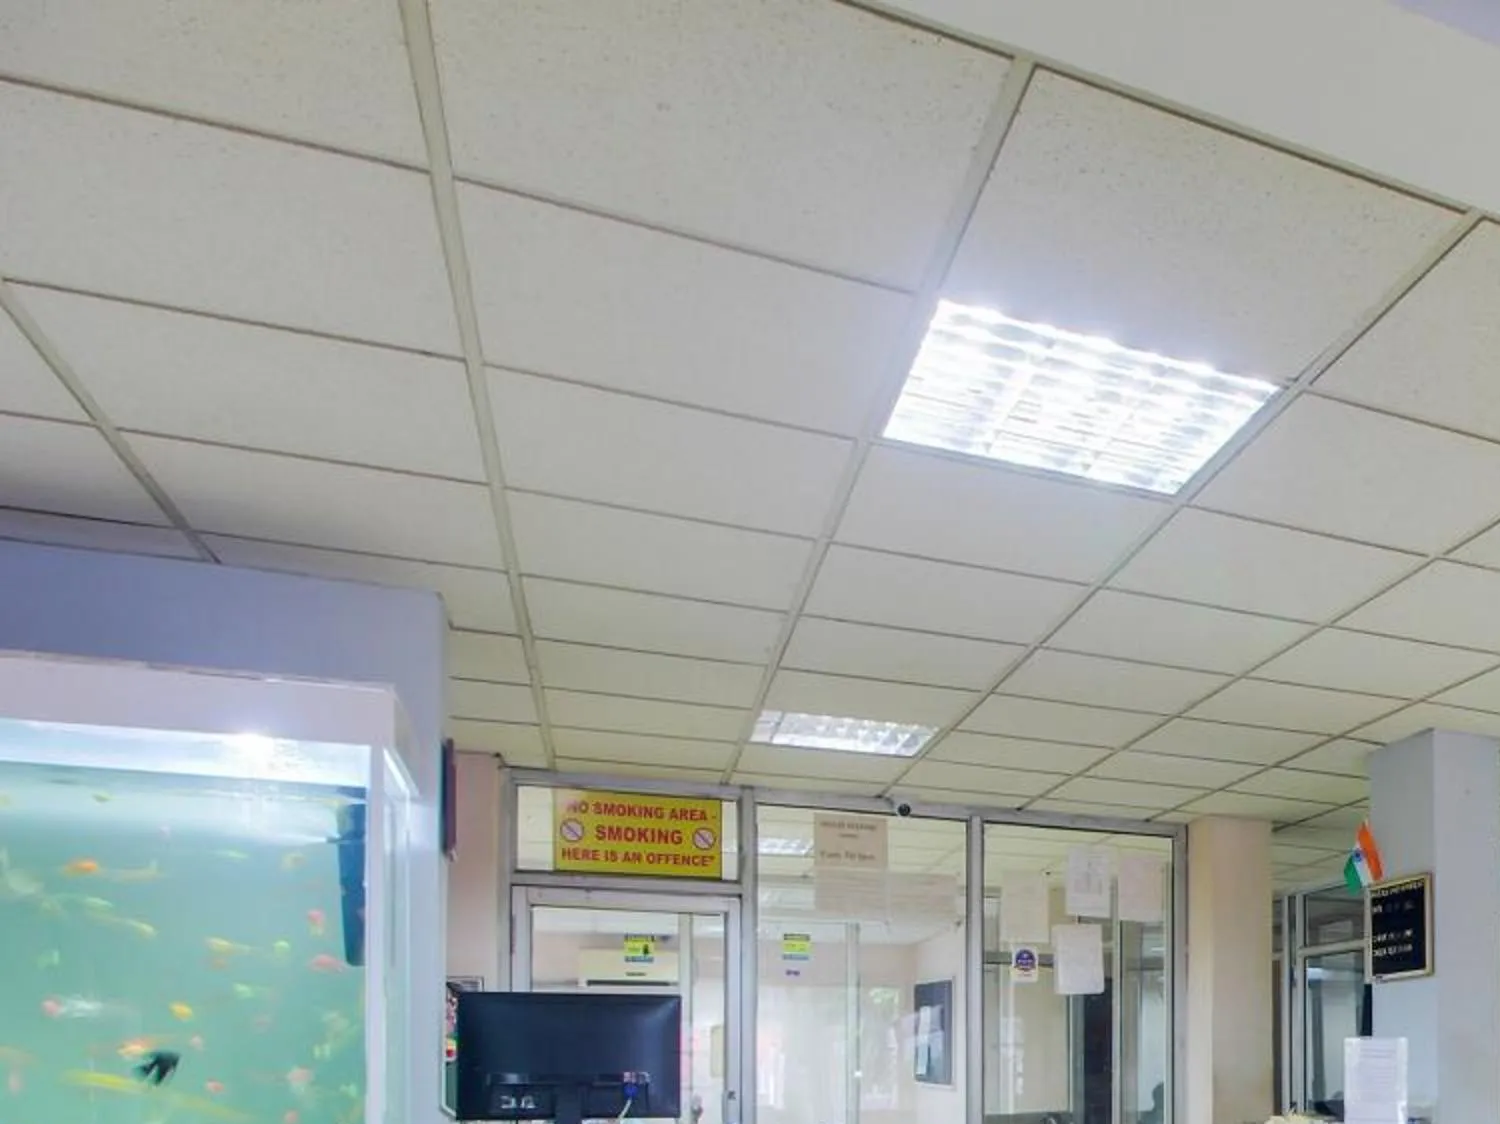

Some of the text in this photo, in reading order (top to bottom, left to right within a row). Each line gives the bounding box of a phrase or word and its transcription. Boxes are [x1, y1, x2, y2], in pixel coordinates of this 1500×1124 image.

[566, 801, 589, 814] NO
[592, 802, 665, 819] SMOKING
[669, 808, 709, 821] AREA
[595, 824, 683, 845] SMOKING
[561, 847, 600, 861] HERE
[605, 850, 619, 863] IS
[623, 851, 641, 864] AN
